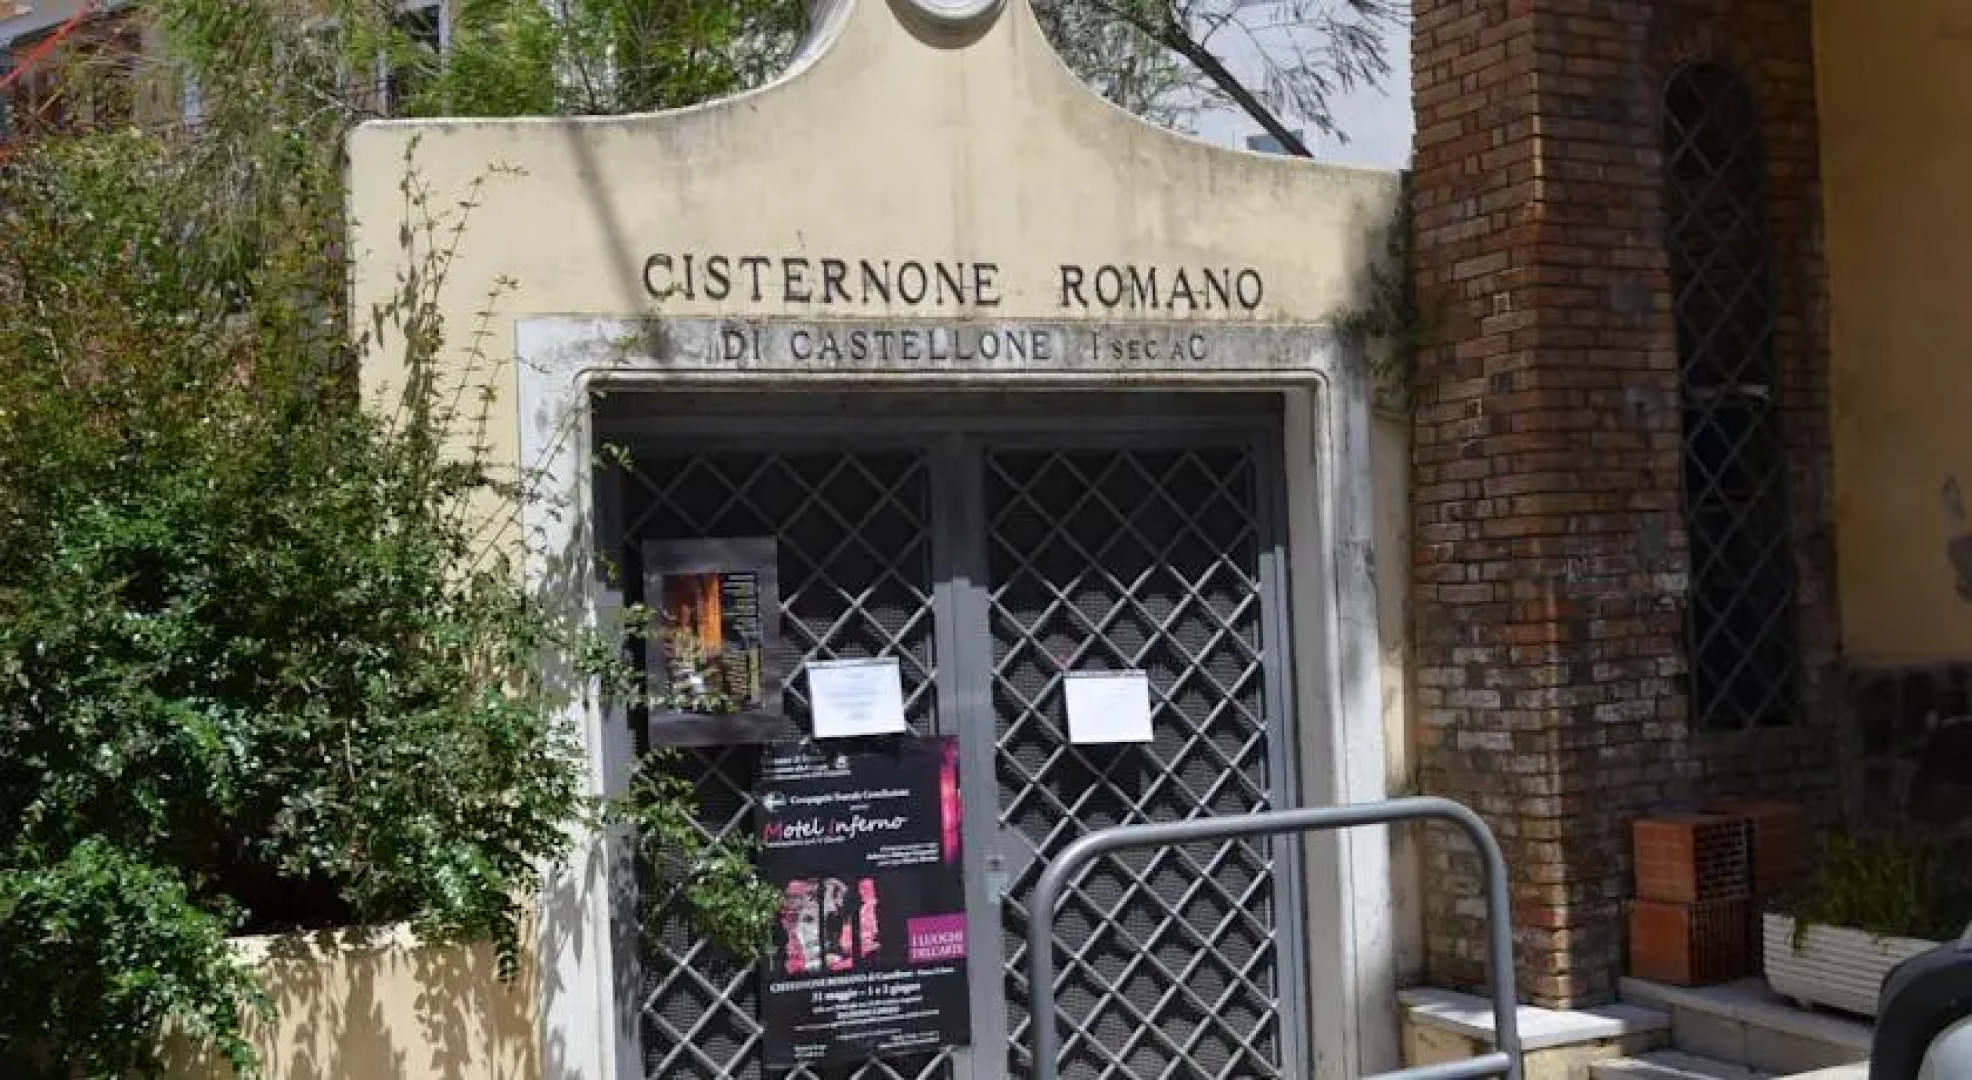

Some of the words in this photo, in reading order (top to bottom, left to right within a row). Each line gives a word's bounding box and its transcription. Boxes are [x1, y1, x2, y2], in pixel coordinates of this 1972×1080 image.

[643, 253, 1000, 305] CISTERNONE
[1059, 264, 1263, 309] ROMANO
[722, 328, 760, 360] DI
[790, 330, 1050, 360] CASTELLONE
[763, 816, 824, 842] Motel
